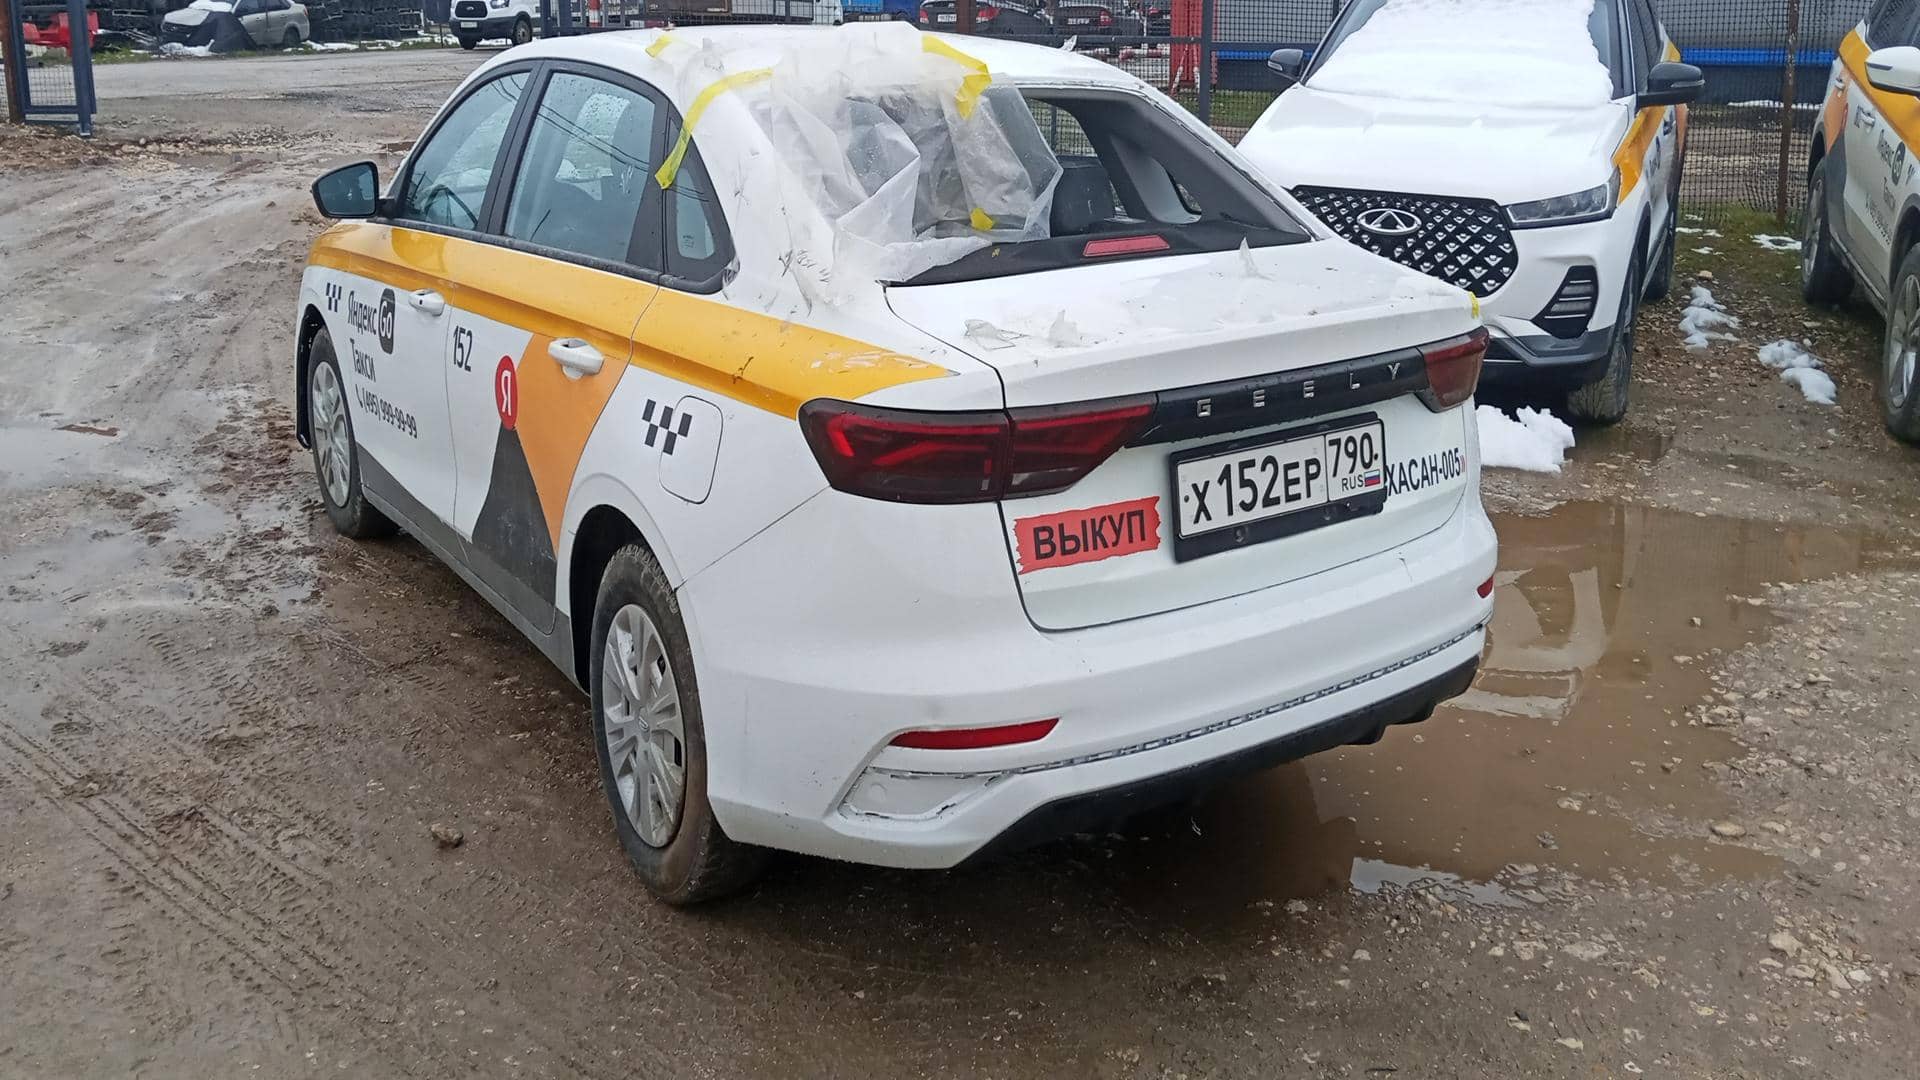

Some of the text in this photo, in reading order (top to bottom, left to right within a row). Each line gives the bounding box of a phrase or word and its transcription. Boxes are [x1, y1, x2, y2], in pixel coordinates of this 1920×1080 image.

[348, 290, 393, 340] Яндекс Go
[350, 337, 377, 383] Такси
[453, 325, 473, 372] 152
[501, 369, 512, 417] Я
[1196, 362, 1401, 417] GEELY
[1328, 432, 1374, 478] 790
[1386, 447, 1461, 497] ХАСАН-005
[1341, 467, 1364, 492] RUS
[1033, 509, 1146, 561] ВЫКУП
